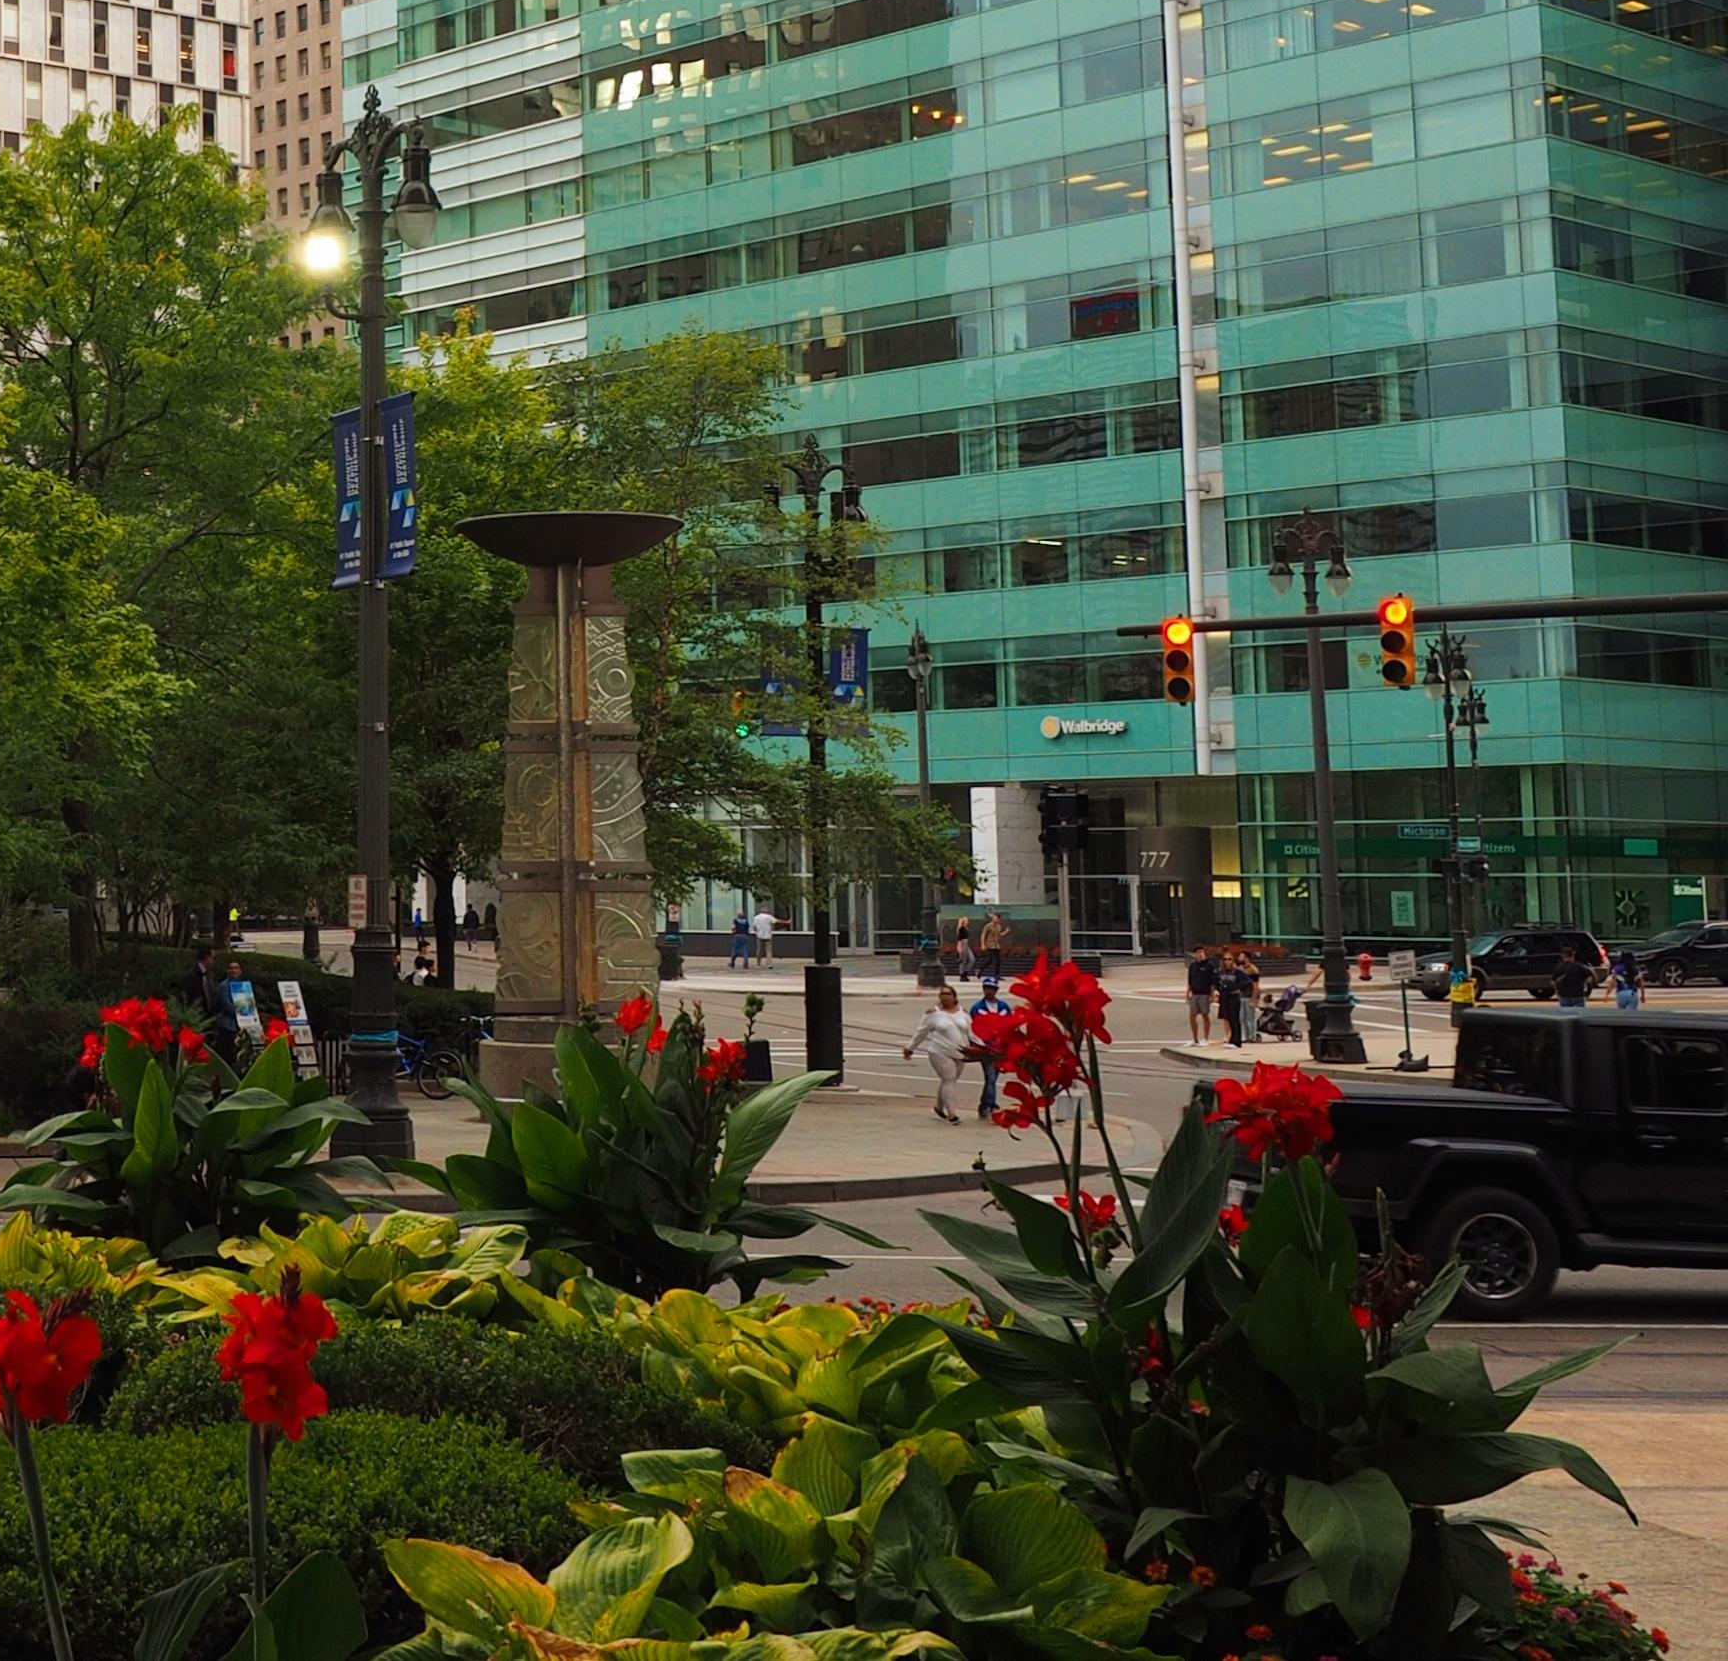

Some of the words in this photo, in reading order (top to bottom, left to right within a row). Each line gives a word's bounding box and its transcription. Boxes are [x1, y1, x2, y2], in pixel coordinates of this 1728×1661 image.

[1061, 719, 1125, 735] Walbridge
[1403, 827, 1446, 838] Michigan
[1294, 844, 1321, 855] Citize
[1483, 843, 1516, 853] itizens
[1139, 851, 1170, 868] 777
